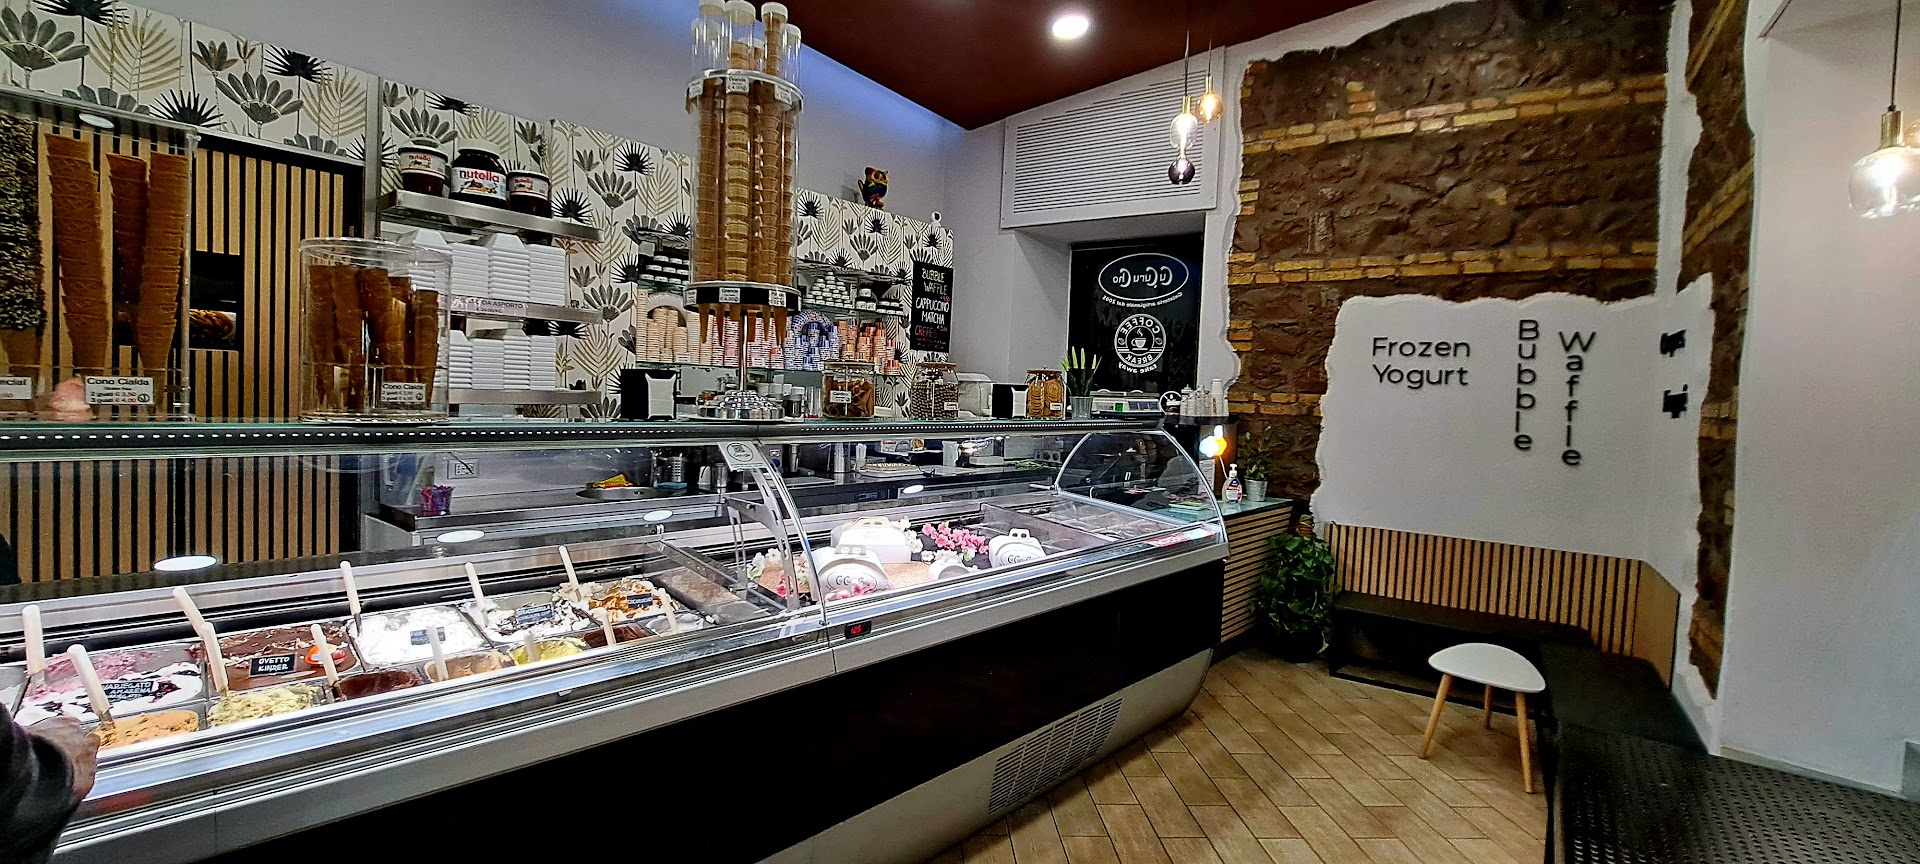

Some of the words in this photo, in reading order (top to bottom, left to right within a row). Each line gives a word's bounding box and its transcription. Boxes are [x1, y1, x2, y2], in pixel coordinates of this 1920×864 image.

[409, 154, 431, 162] nutella
[459, 170, 500, 182] nutella
[922, 268, 945, 282] BUBBLE
[924, 281, 948, 295] WAFFLE
[916, 297, 950, 312] CAPPUCCINO
[922, 311, 945, 325] MATCHA
[1372, 336, 1471, 358] Frozen
[1372, 364, 1469, 390] Yogurt
[1514, 320, 1540, 450] Bubble
[1559, 331, 1596, 466] Waffle
[258, 656, 290, 665] OVETTO
[258, 664, 289, 672] KINDER
